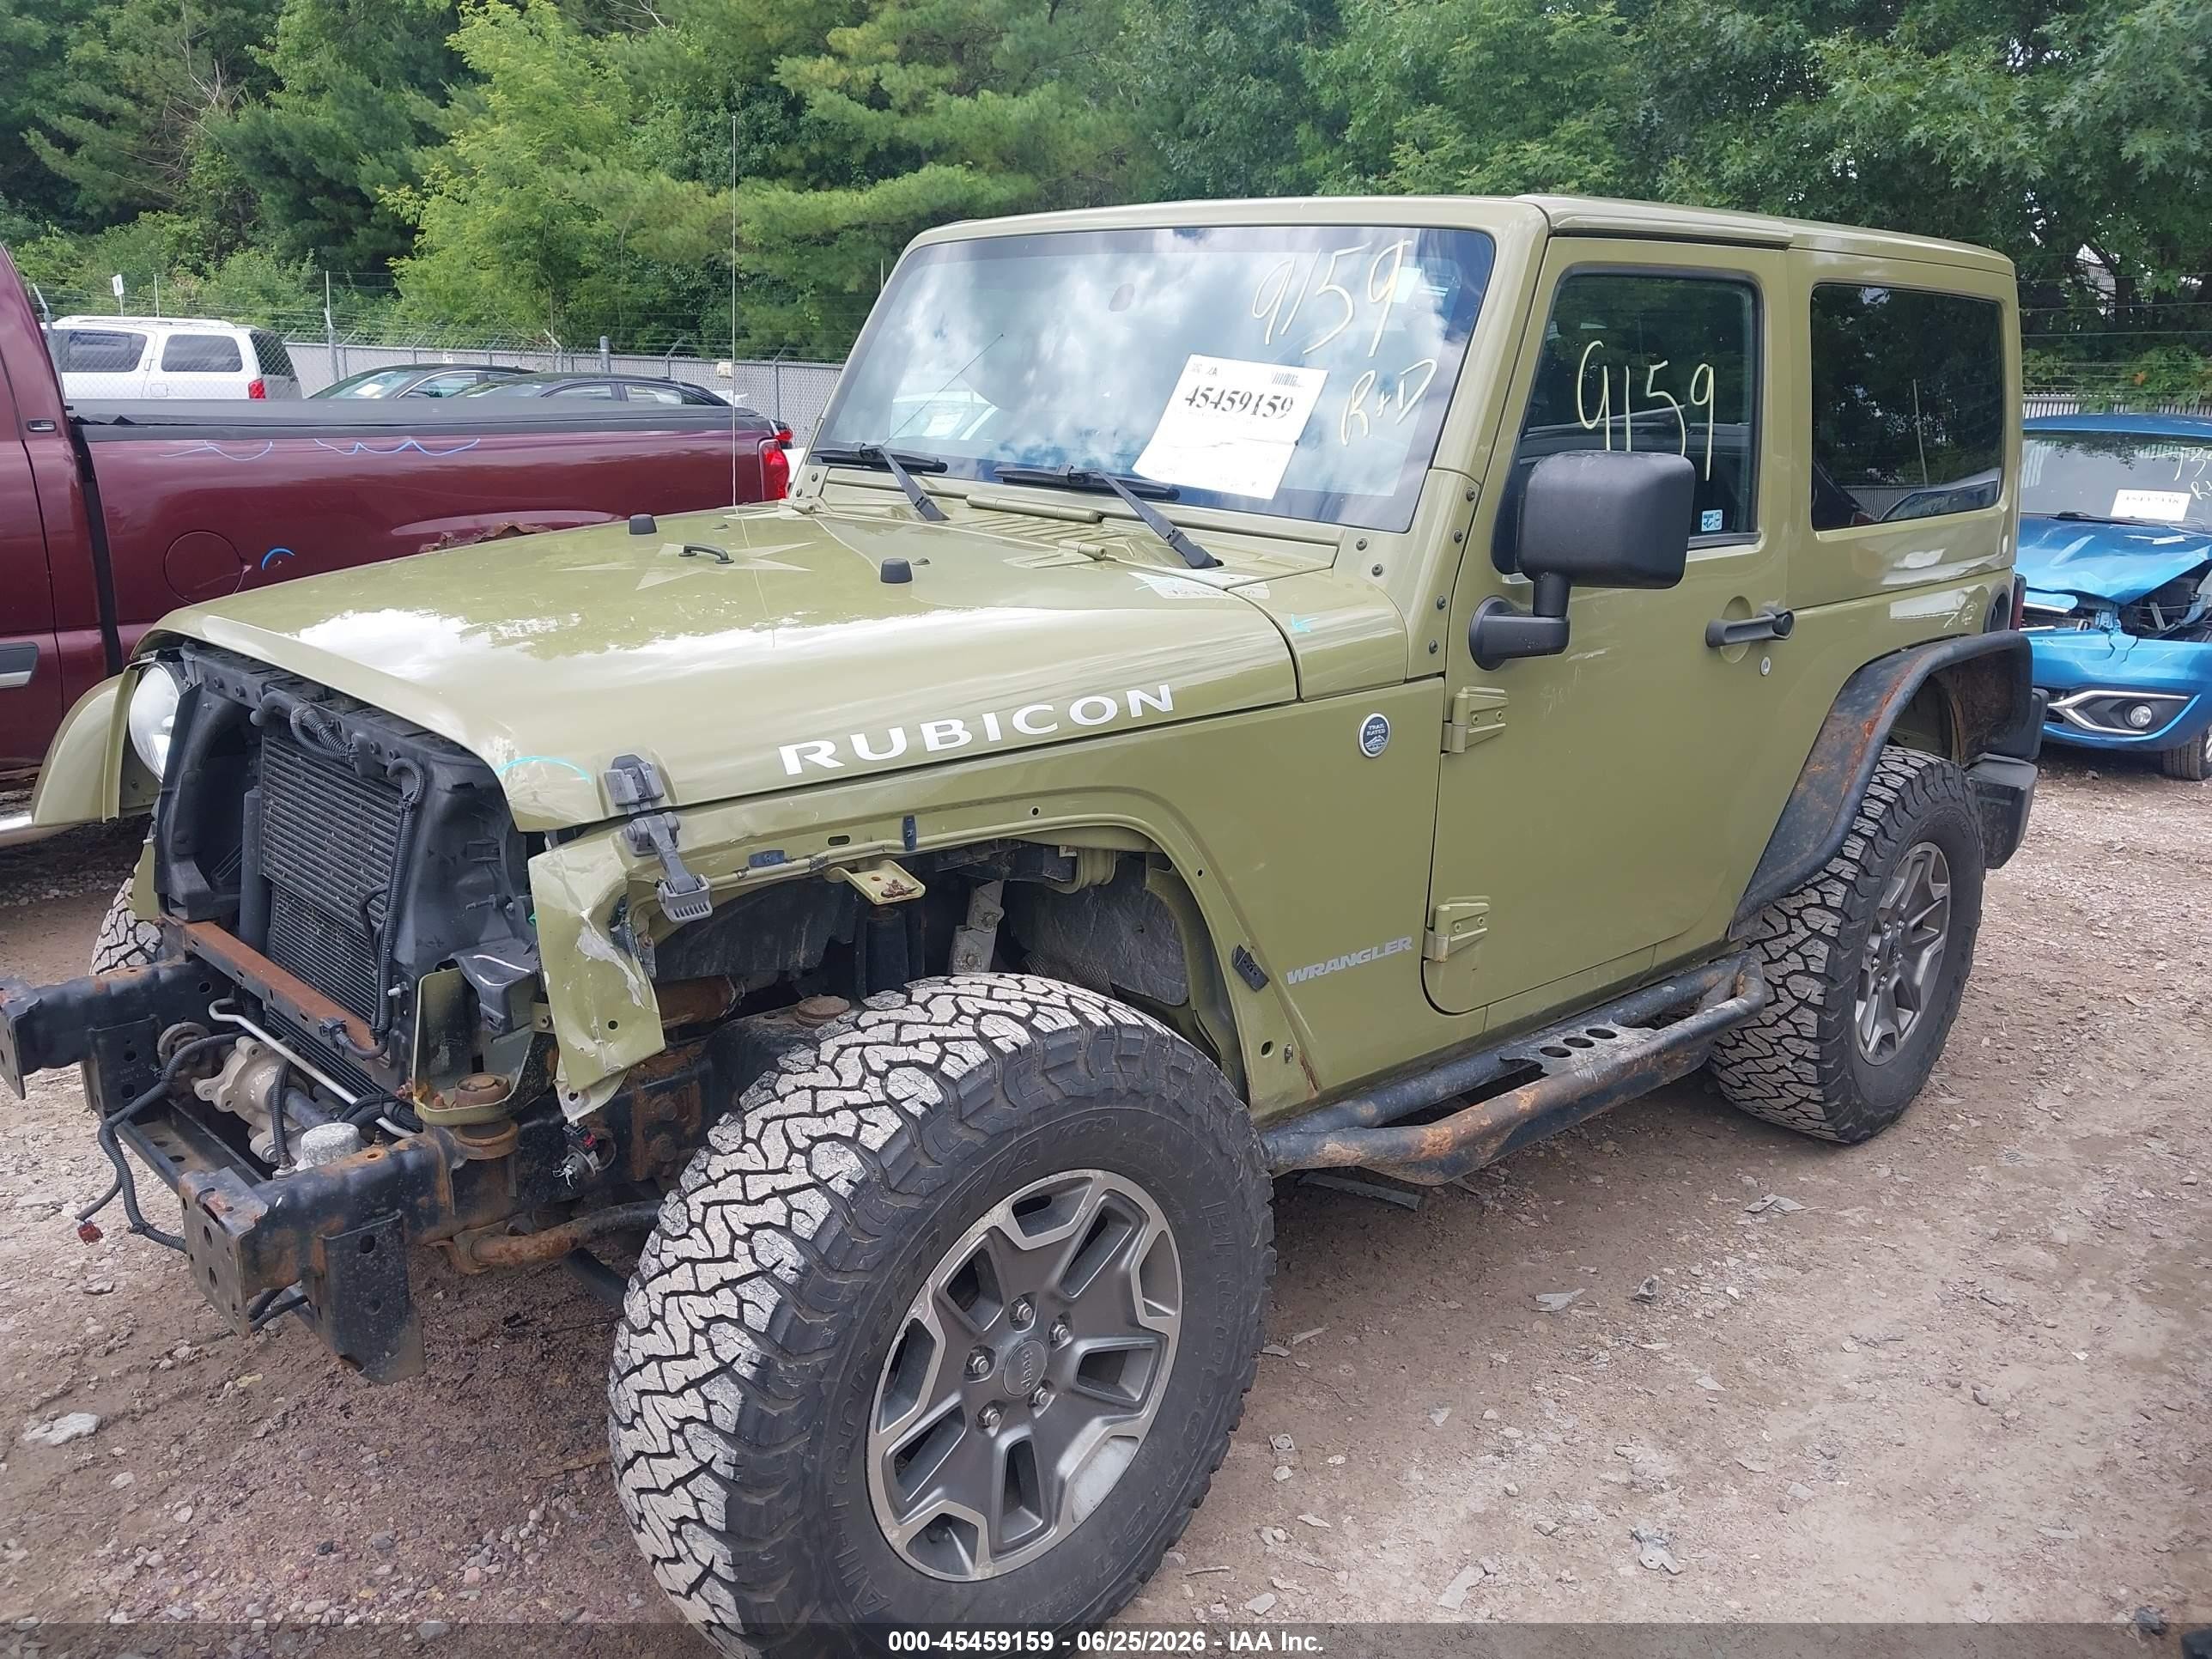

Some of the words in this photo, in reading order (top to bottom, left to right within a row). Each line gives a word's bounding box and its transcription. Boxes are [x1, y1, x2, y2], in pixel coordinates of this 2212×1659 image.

[1252, 238, 1413, 356] 9159
[1185, 384, 1293, 419] 45459159
[1577, 340, 1715, 481] 9159
[2149, 445, 2212, 482] 73
[778, 684, 1174, 775] RUBICON
[1285, 935, 1413, 986] WRANGLER
